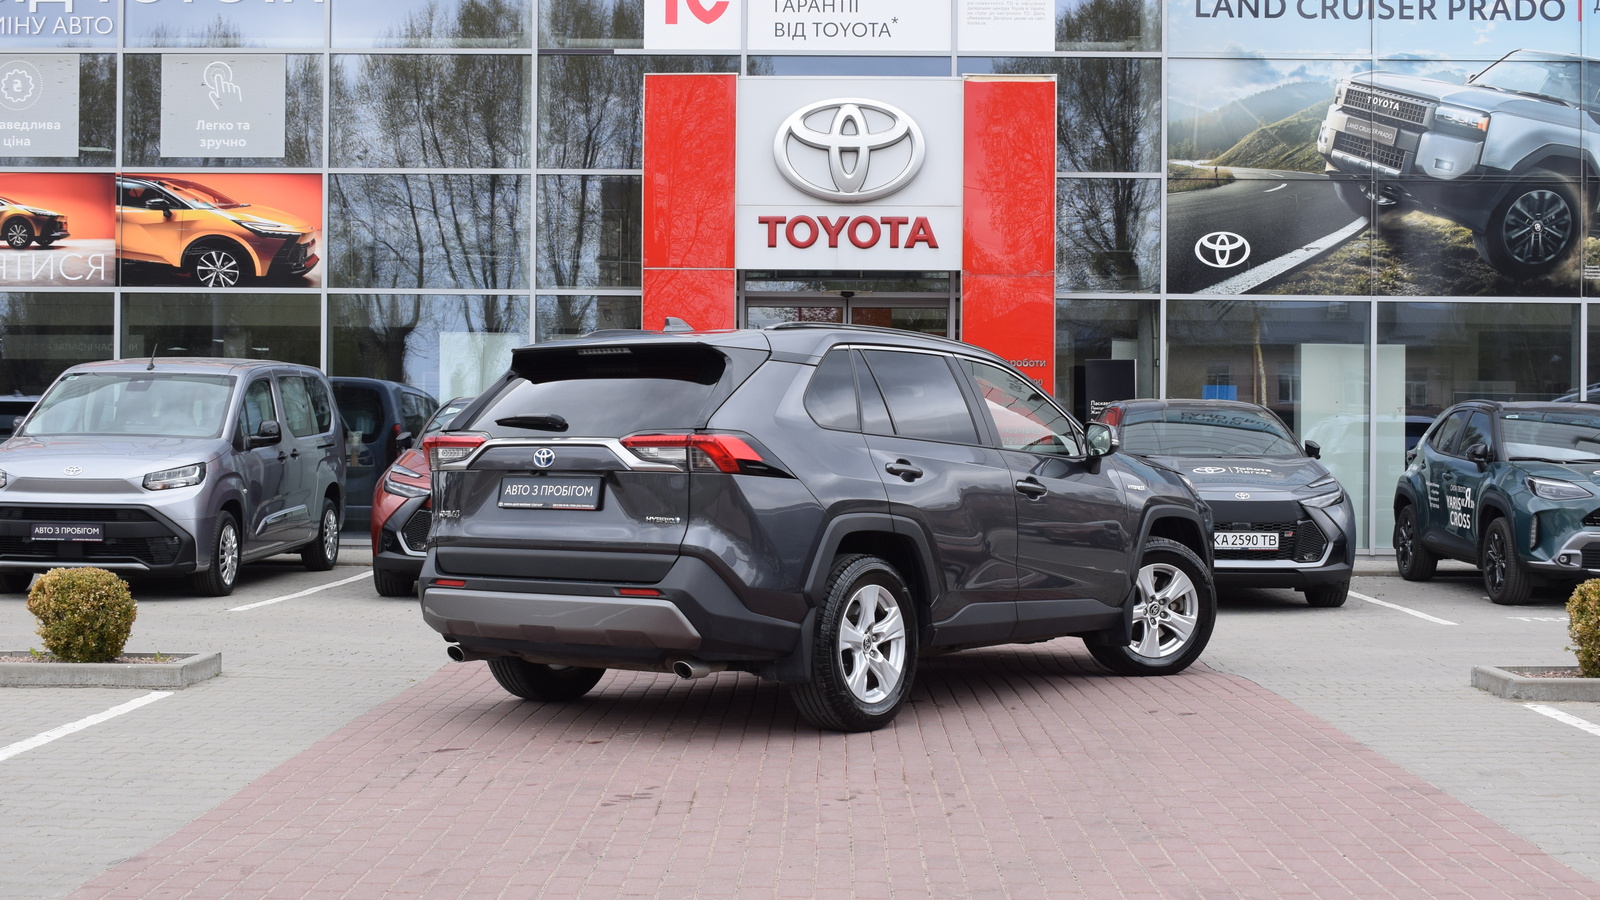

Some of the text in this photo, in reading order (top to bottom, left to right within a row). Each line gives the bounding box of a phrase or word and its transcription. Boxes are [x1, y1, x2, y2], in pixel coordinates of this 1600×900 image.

[1195, 0, 1566, 22] LAND CRUISER PRADO
[52, 16, 113, 34] АВТО
[774, 22, 807, 41] ВІД
[1367, 96, 1399, 111] TOYOTA
[196, 119, 250, 131] Легко та
[3, 136, 31, 148] ціна
[200, 138, 247, 149] зручно
[758, 215, 939, 249] TOYOTA
[505, 485, 594, 497] АВТО З ПРОБІГОМ
[1450, 511, 1471, 529] CROSS
[1231, 534, 1259, 546] 2590
